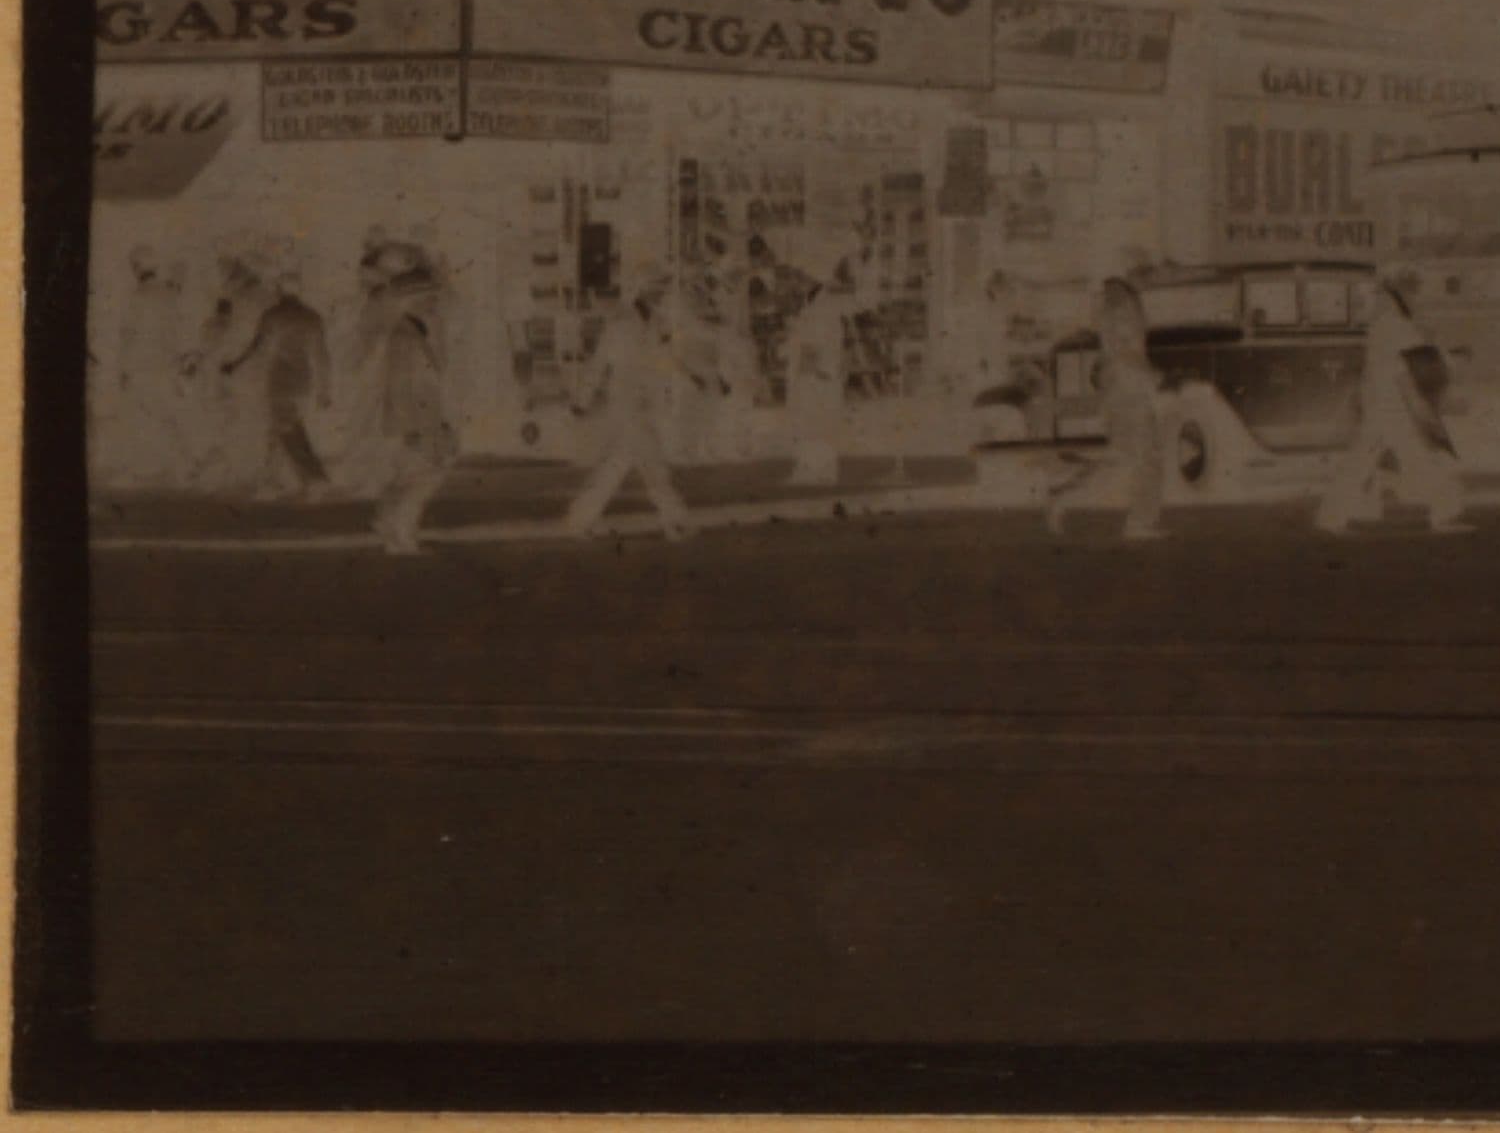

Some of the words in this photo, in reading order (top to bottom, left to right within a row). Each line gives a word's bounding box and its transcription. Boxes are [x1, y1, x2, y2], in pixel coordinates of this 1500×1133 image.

[636, 8, 879, 66] CIGARS
[1256, 62, 1368, 101] GAIETY
[1377, 71, 1496, 105] THEATRE
